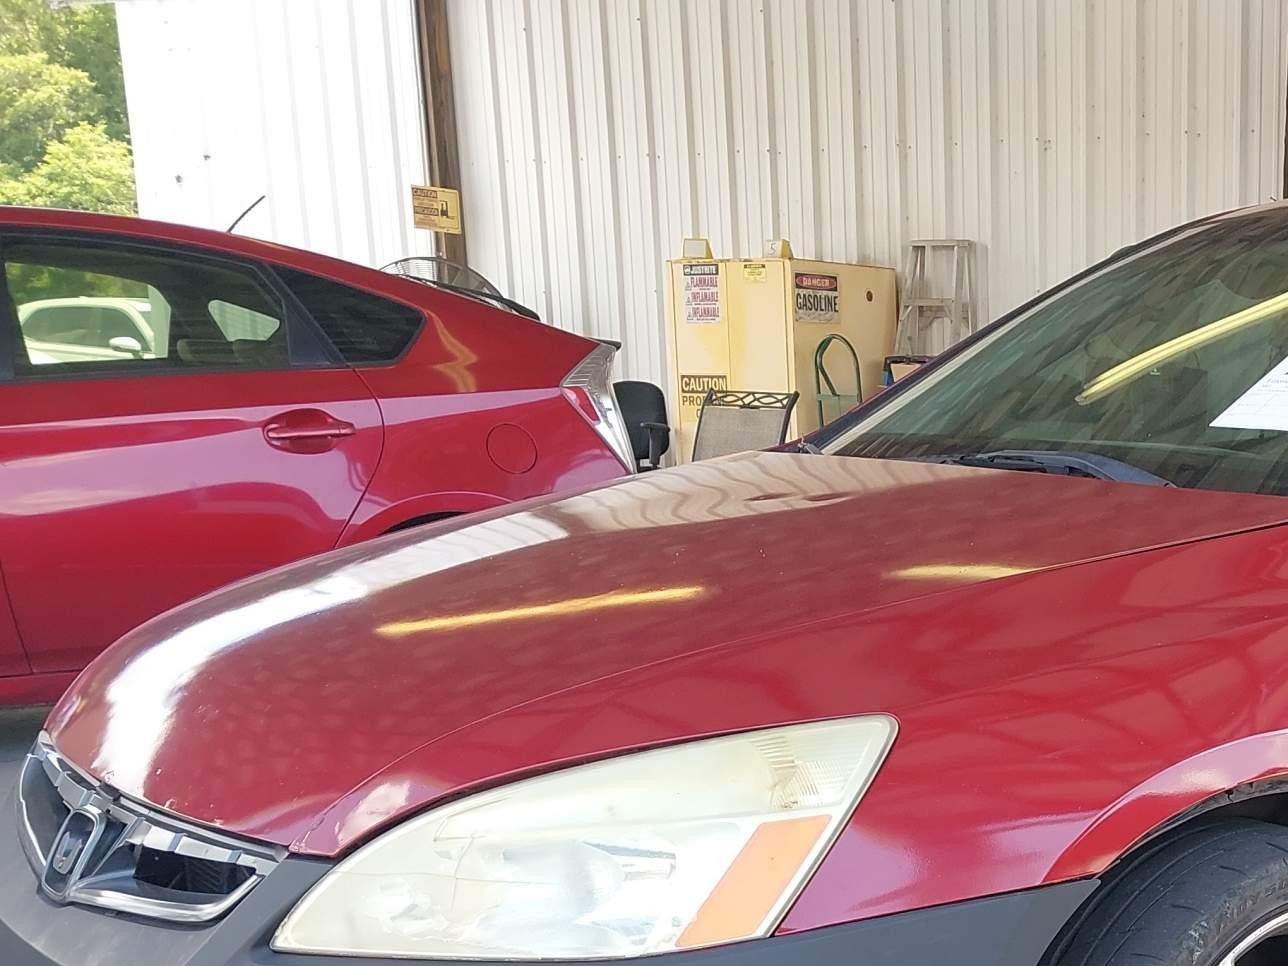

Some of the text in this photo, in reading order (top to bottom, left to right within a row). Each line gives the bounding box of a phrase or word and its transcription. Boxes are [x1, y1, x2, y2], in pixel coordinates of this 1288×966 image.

[802, 277, 830, 287] DANGER
[796, 293, 839, 312] GASOLINE
[682, 377, 727, 391] CAUTION
